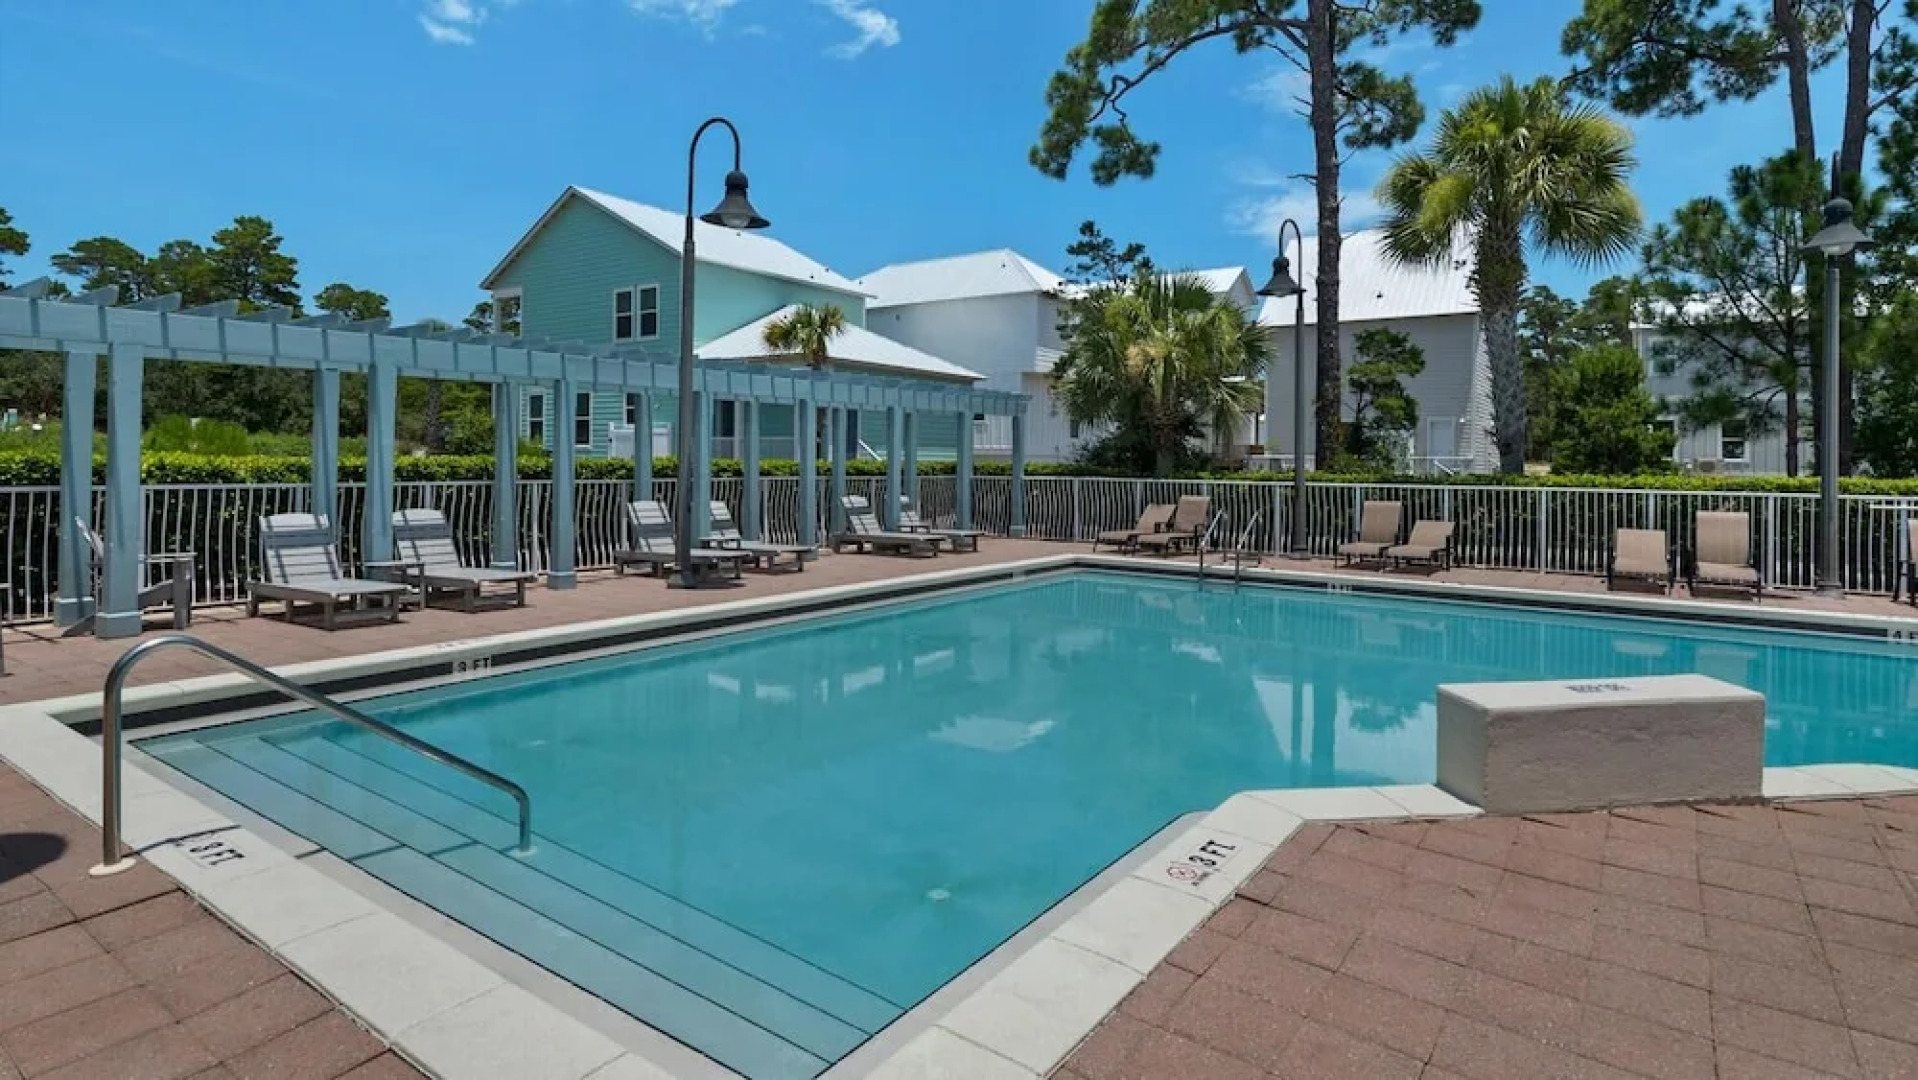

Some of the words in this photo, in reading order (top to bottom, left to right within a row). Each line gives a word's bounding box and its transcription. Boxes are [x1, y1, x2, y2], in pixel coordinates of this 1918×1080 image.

[473, 657, 490, 671] FT
[189, 841, 224, 853] 3
[1199, 839, 1236, 858] FT
[200, 848, 245, 866] FT
[1189, 854, 1217, 867] 3
